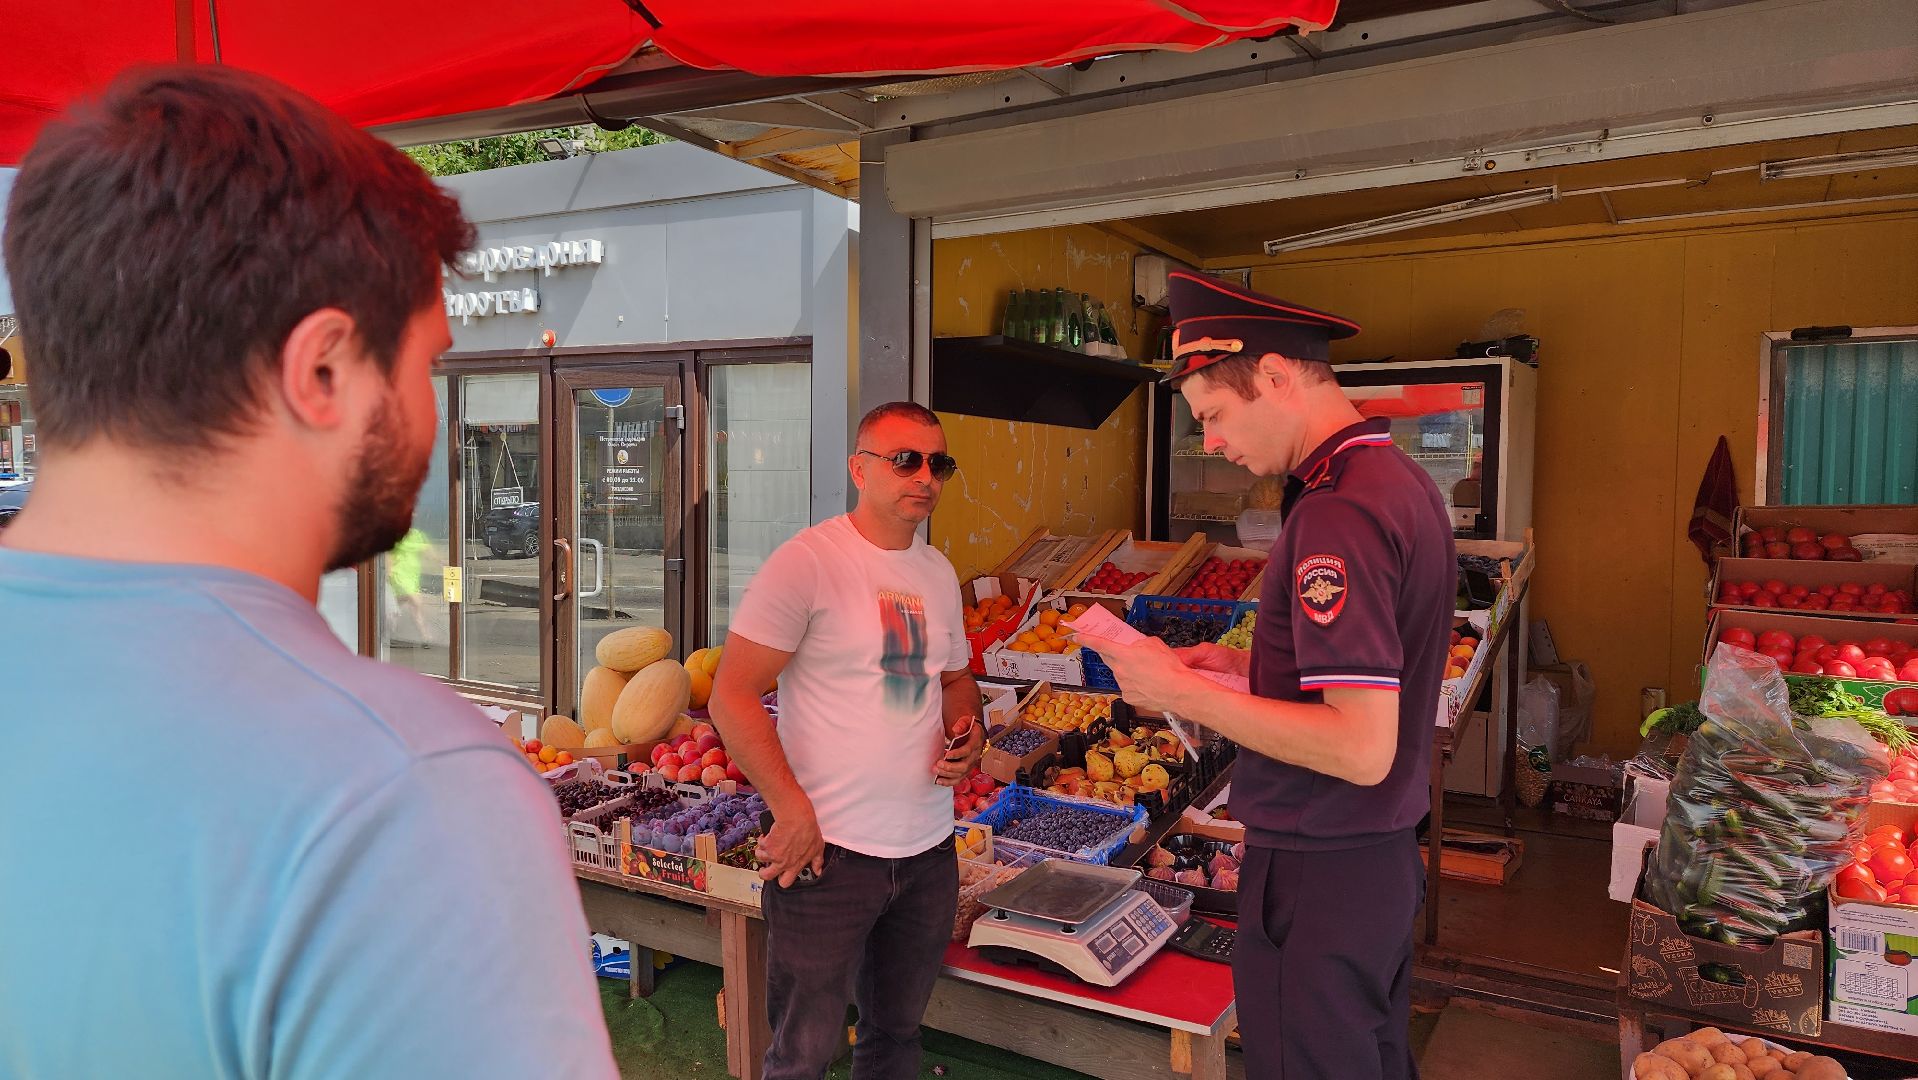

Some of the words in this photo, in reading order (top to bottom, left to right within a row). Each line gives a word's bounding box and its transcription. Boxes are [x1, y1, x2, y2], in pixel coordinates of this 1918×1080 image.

[1298, 557, 1341, 575] ПОЛИЦИЯ
[1303, 568, 1337, 584] РОССИЯ
[877, 591, 925, 609] ARMANI
[1314, 611, 1334, 623] МВД
[652, 857, 684, 872] Selected
[661, 869, 690, 882] Fruits
